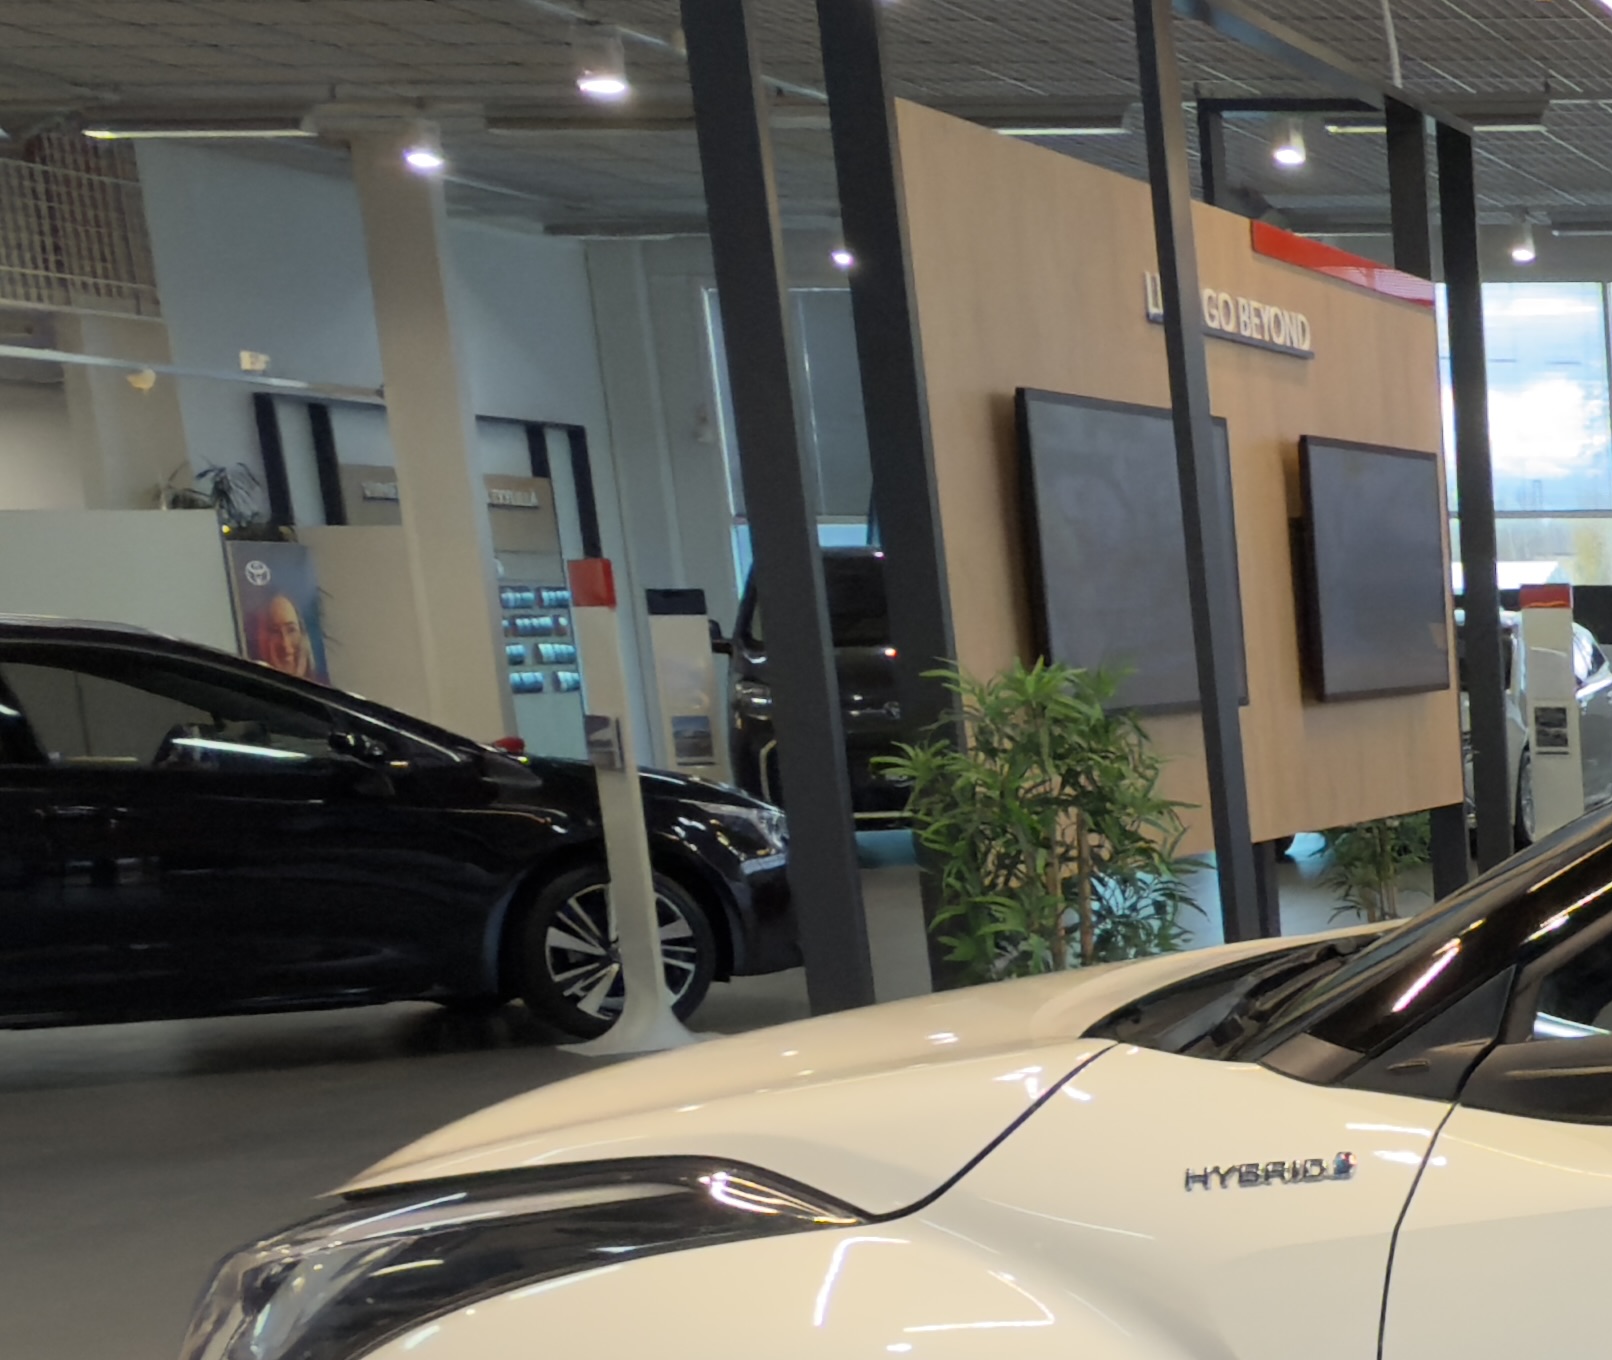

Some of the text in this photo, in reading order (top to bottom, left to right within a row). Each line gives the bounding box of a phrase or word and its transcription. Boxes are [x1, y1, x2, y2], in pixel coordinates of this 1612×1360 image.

[1202, 288, 1236, 332] GO
[1239, 297, 1311, 351] BEYOND
[1184, 1158, 1329, 1192] HYBRID
